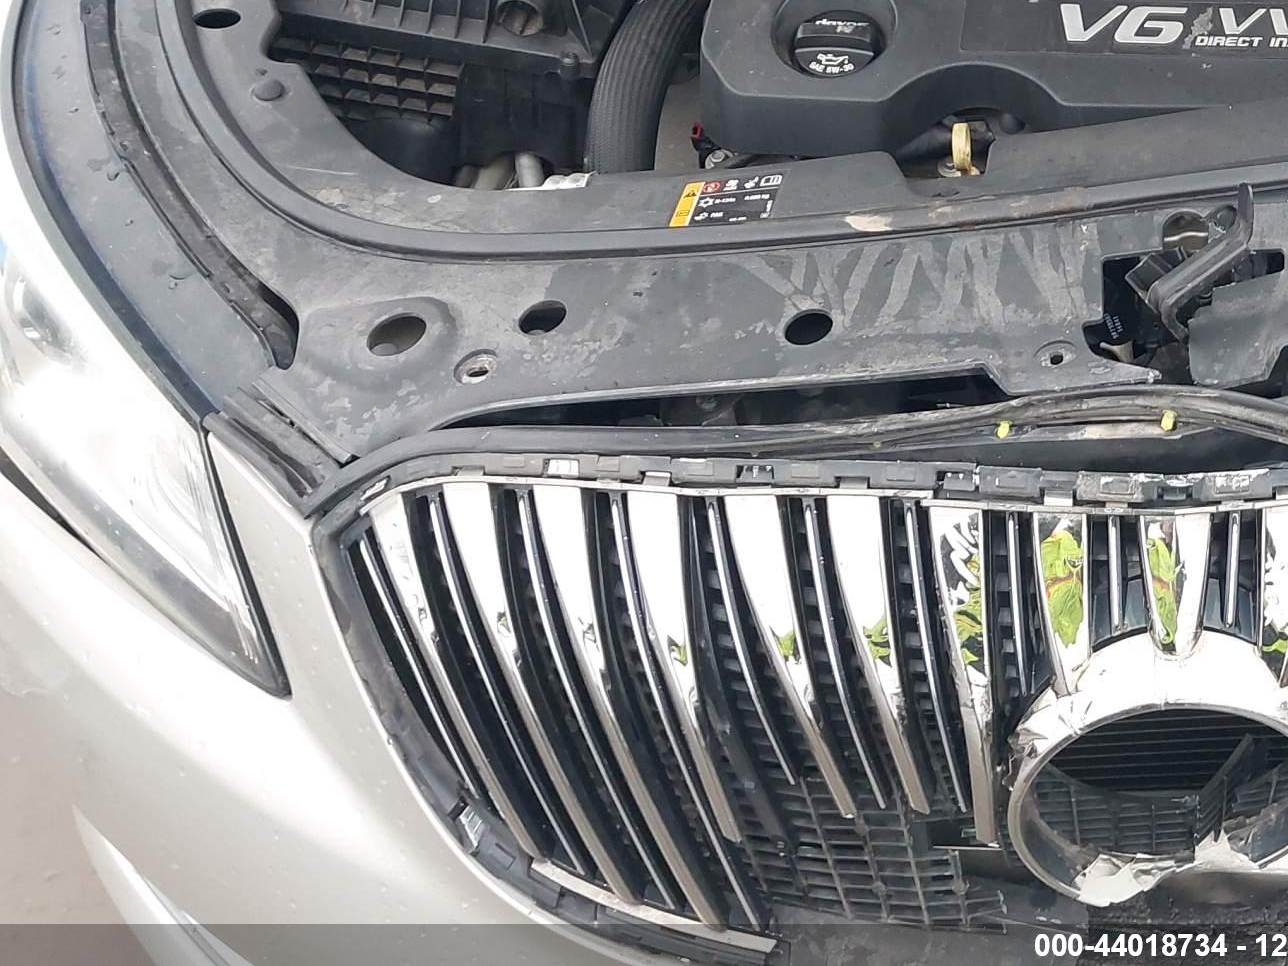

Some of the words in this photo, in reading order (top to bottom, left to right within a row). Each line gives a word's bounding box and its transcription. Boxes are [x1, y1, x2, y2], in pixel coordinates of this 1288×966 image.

[1060, 3, 1188, 44] V6
[1195, 36, 1262, 48] DIRECT
[809, 61, 826, 73] SAE
